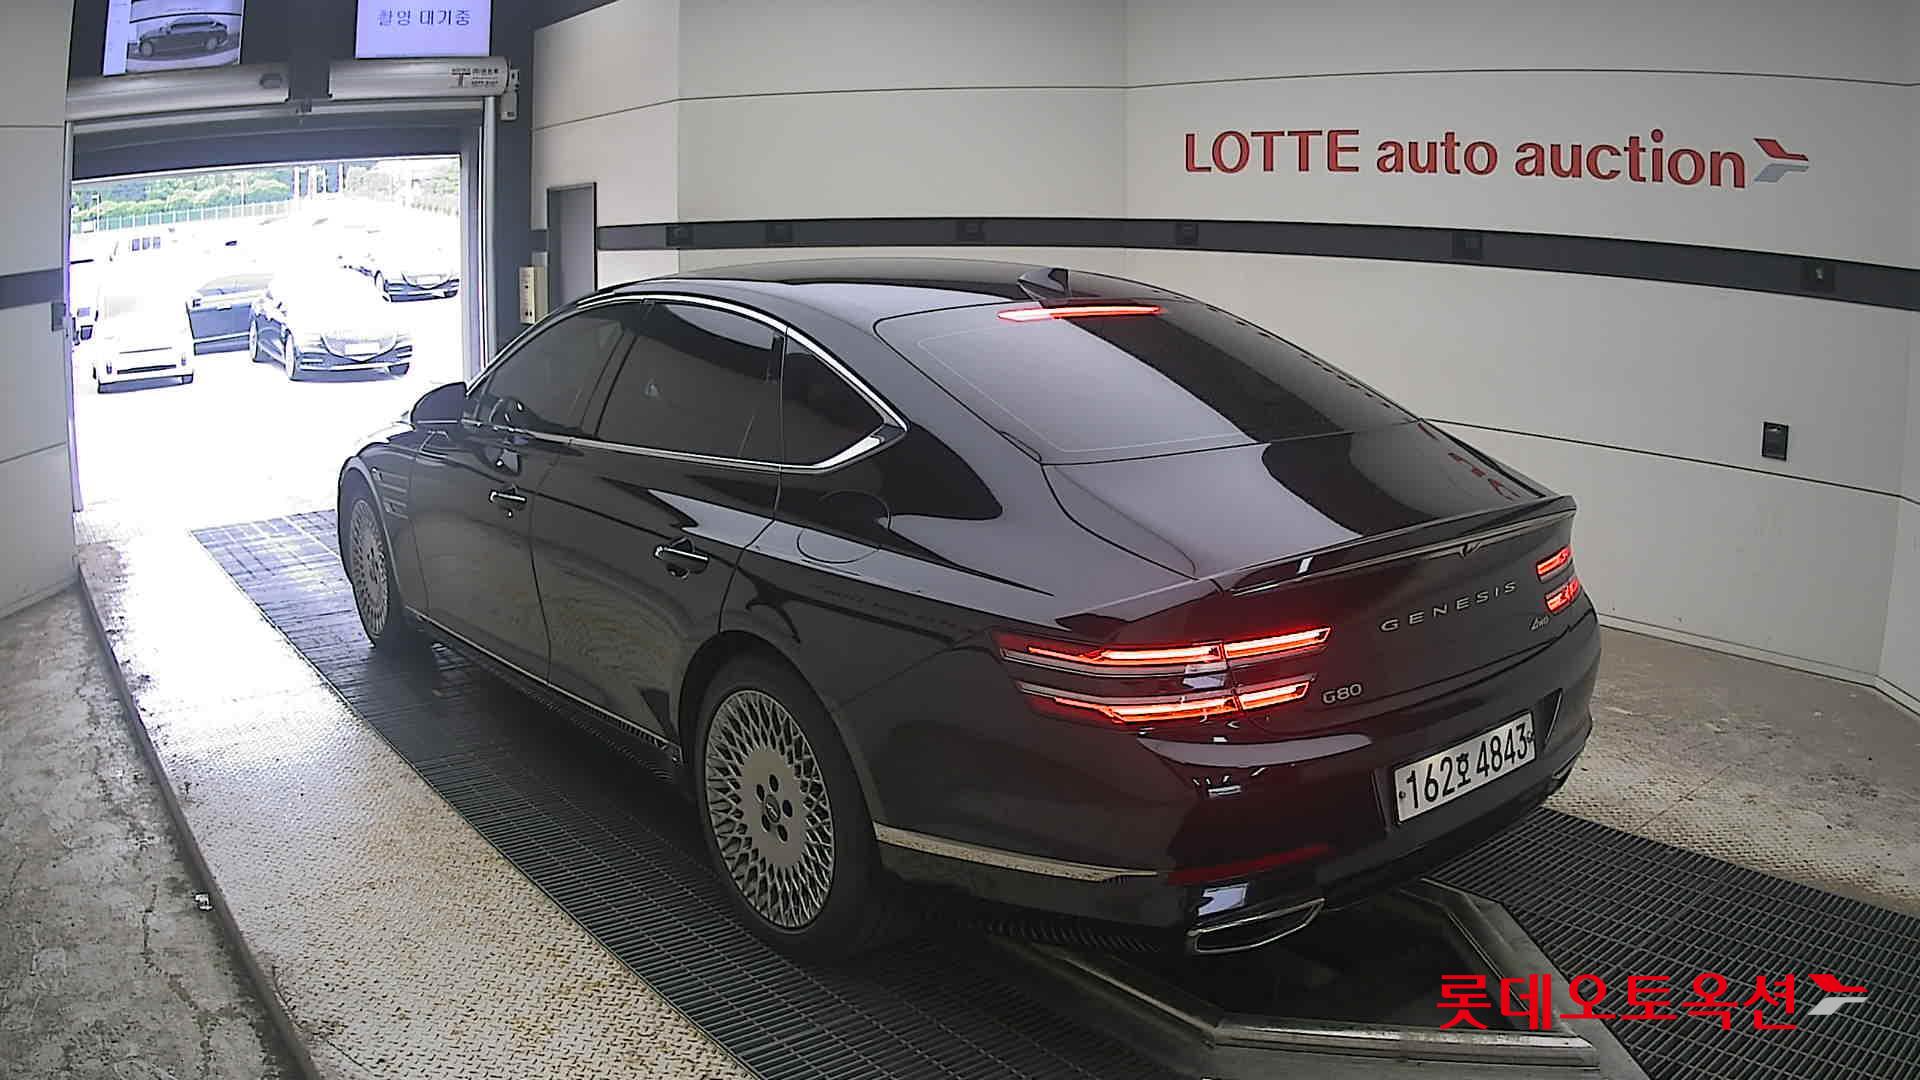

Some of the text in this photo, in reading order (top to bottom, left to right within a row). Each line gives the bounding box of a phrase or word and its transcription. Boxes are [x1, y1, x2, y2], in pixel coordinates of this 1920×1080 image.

[419, 8, 471, 26] 대기중
[1185, 129, 1746, 188] LOTTE auto auction
[1380, 581, 1516, 632] GENESIS
[1323, 683, 1363, 704] G80
